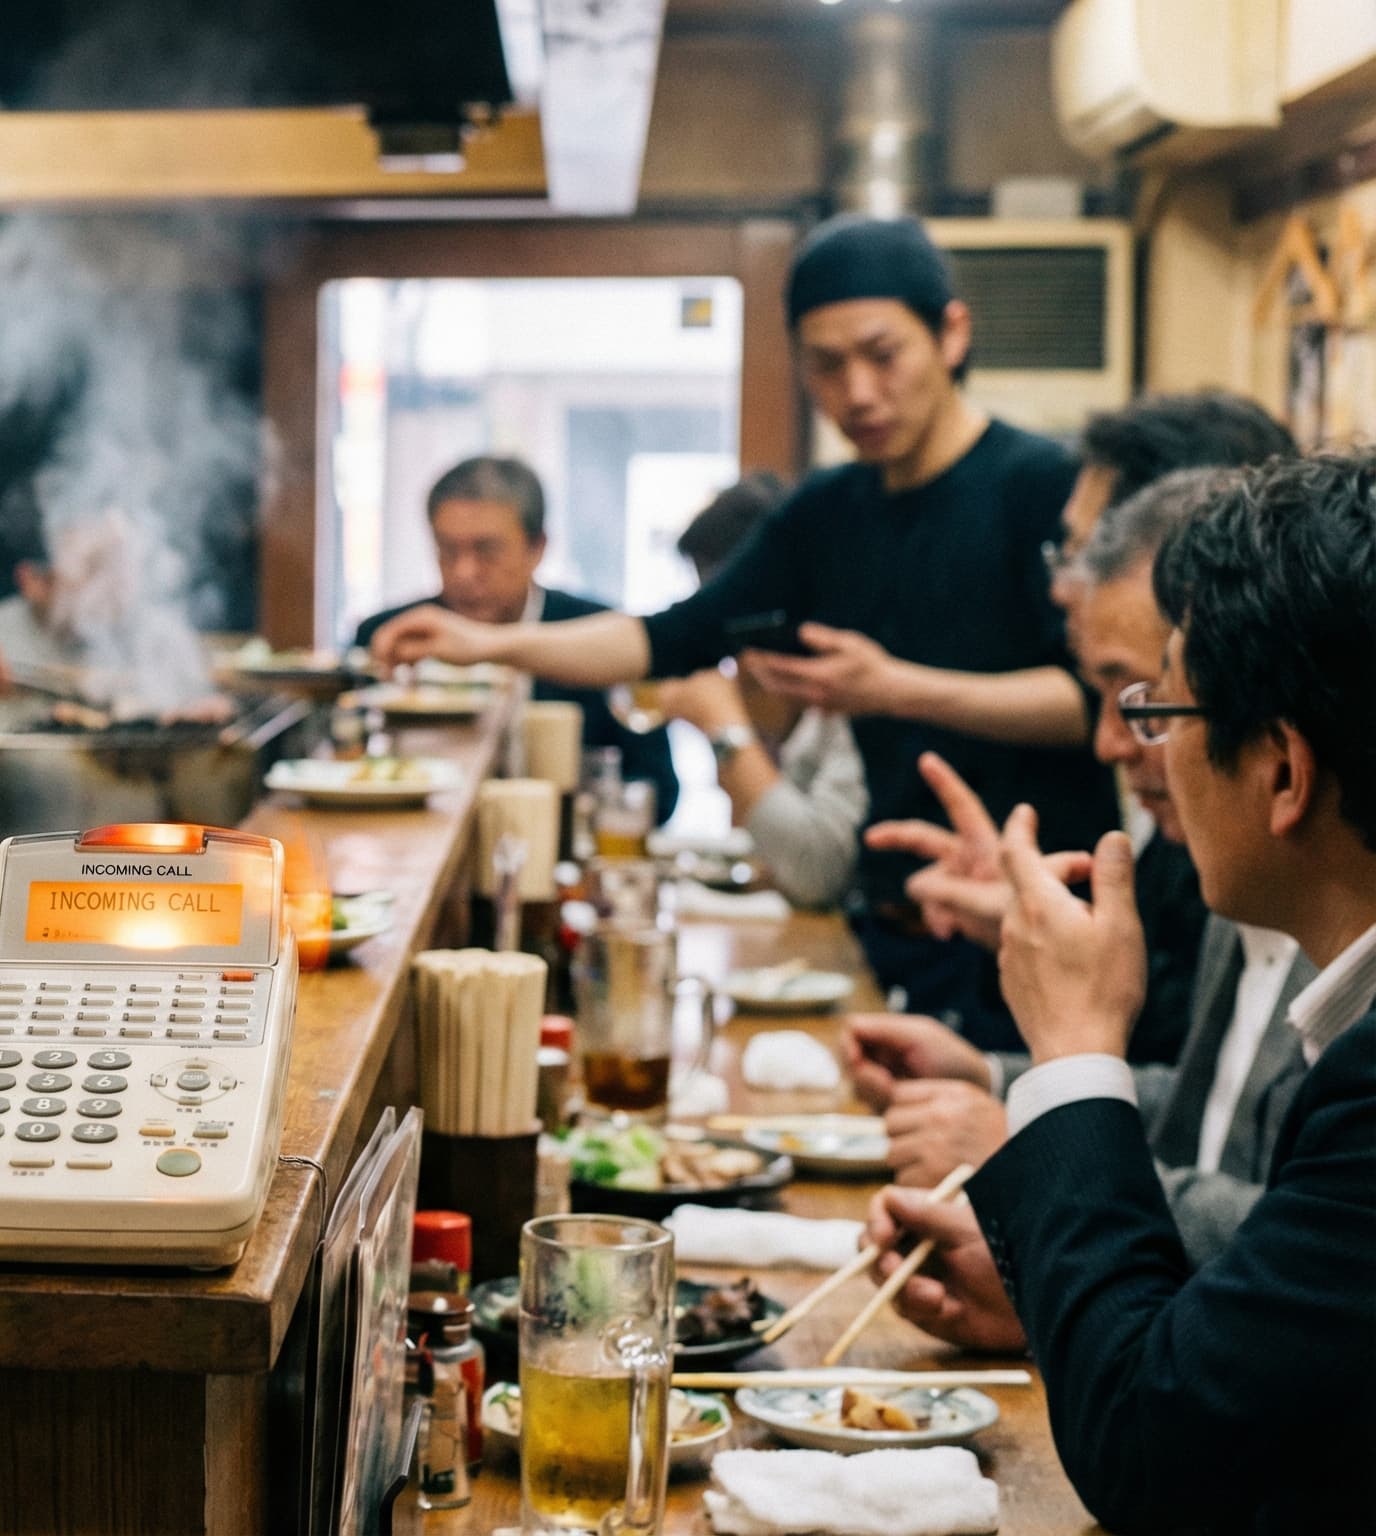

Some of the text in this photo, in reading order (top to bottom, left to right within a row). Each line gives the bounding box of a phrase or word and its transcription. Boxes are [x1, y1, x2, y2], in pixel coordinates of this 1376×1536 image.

[82, 864, 192, 876] INCOMING CALL
[49, 891, 221, 913] INCOMING CALL
[49, 1052, 62, 1062] 2
[102, 1052, 116, 1063] 3
[42, 1074, 56, 1086] 5
[97, 1076, 111, 1087] 6
[36, 1099, 50, 1109] 8
[92, 1099, 107, 1110] 9
[30, 1123, 45, 1135] 0
